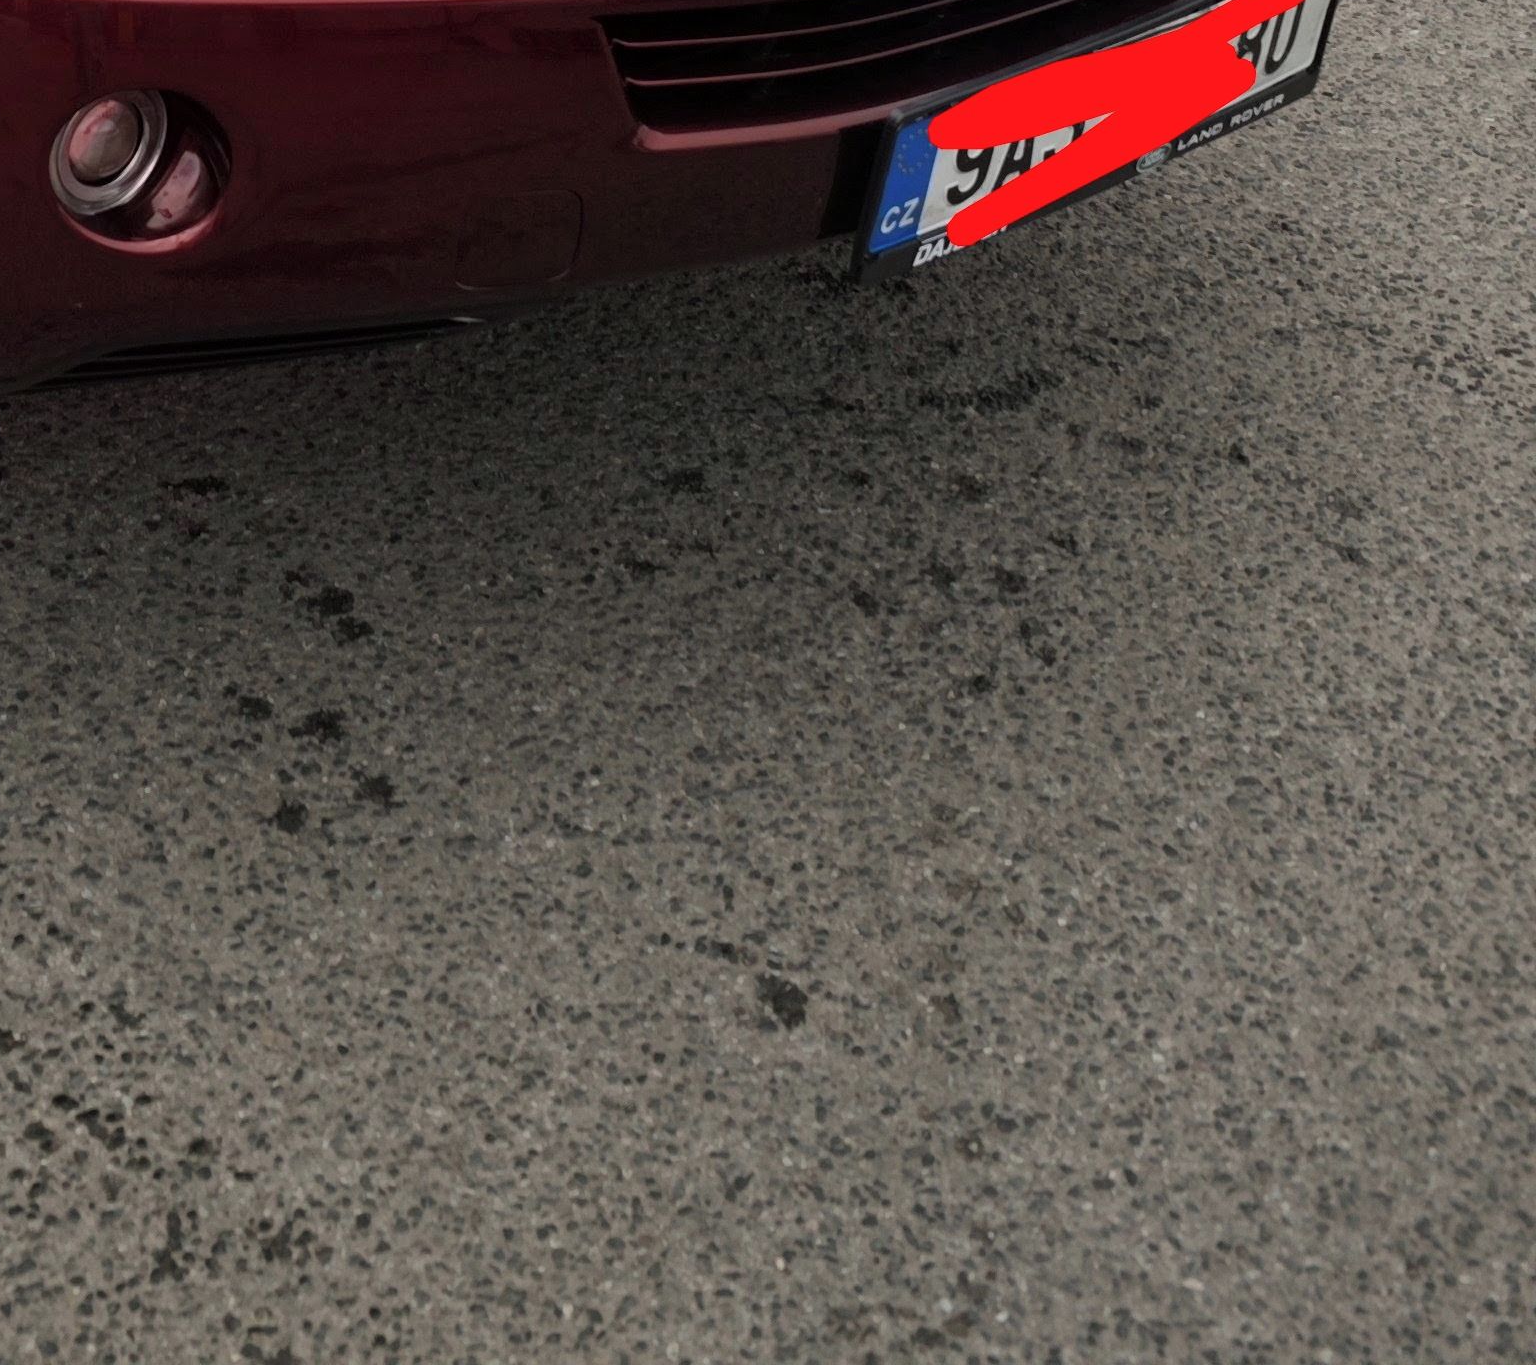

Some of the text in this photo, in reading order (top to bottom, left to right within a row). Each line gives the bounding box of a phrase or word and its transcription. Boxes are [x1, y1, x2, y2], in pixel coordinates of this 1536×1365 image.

[1177, 93, 1285, 151] LAND ROVER
[880, 196, 920, 236] CZ
